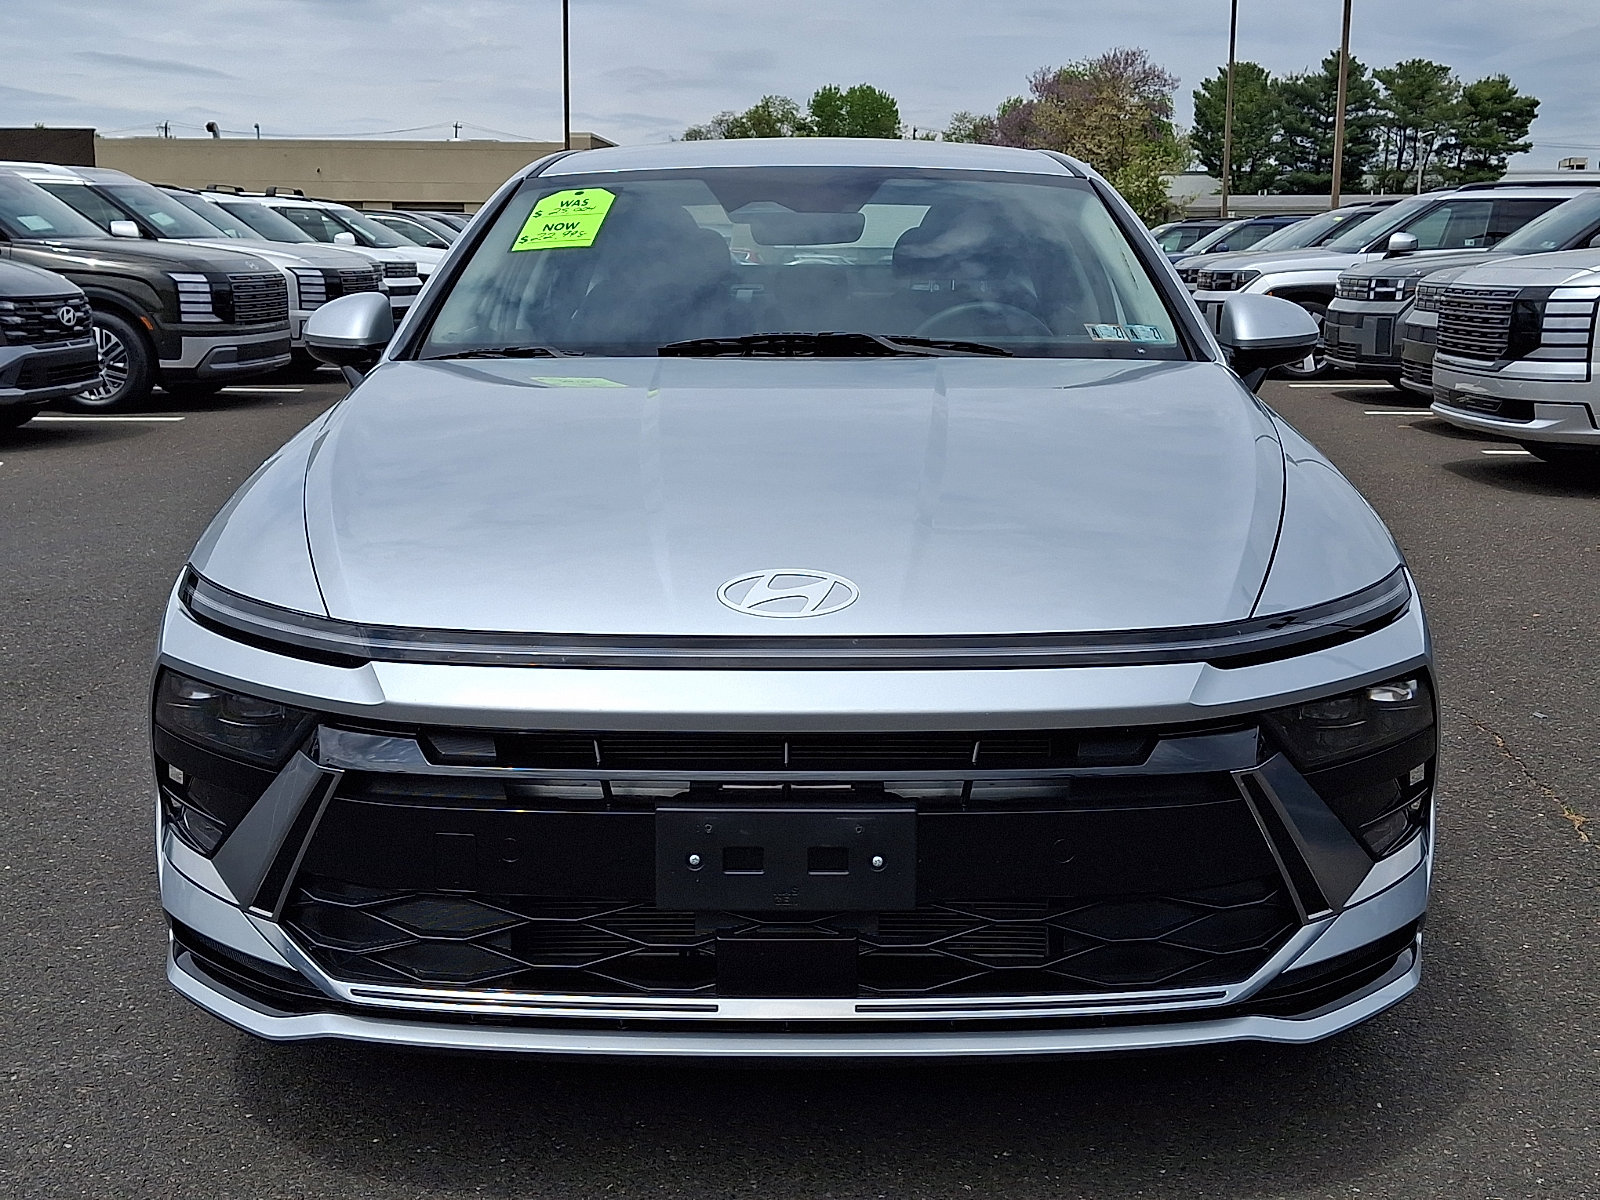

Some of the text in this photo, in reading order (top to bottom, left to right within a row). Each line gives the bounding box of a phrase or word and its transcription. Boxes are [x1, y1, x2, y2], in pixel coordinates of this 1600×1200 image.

[560, 198, 589, 207] WAS
[542, 221, 580, 231] NOW
[1112, 326, 1125, 339] 27
[1149, 327, 1162, 339] 27
